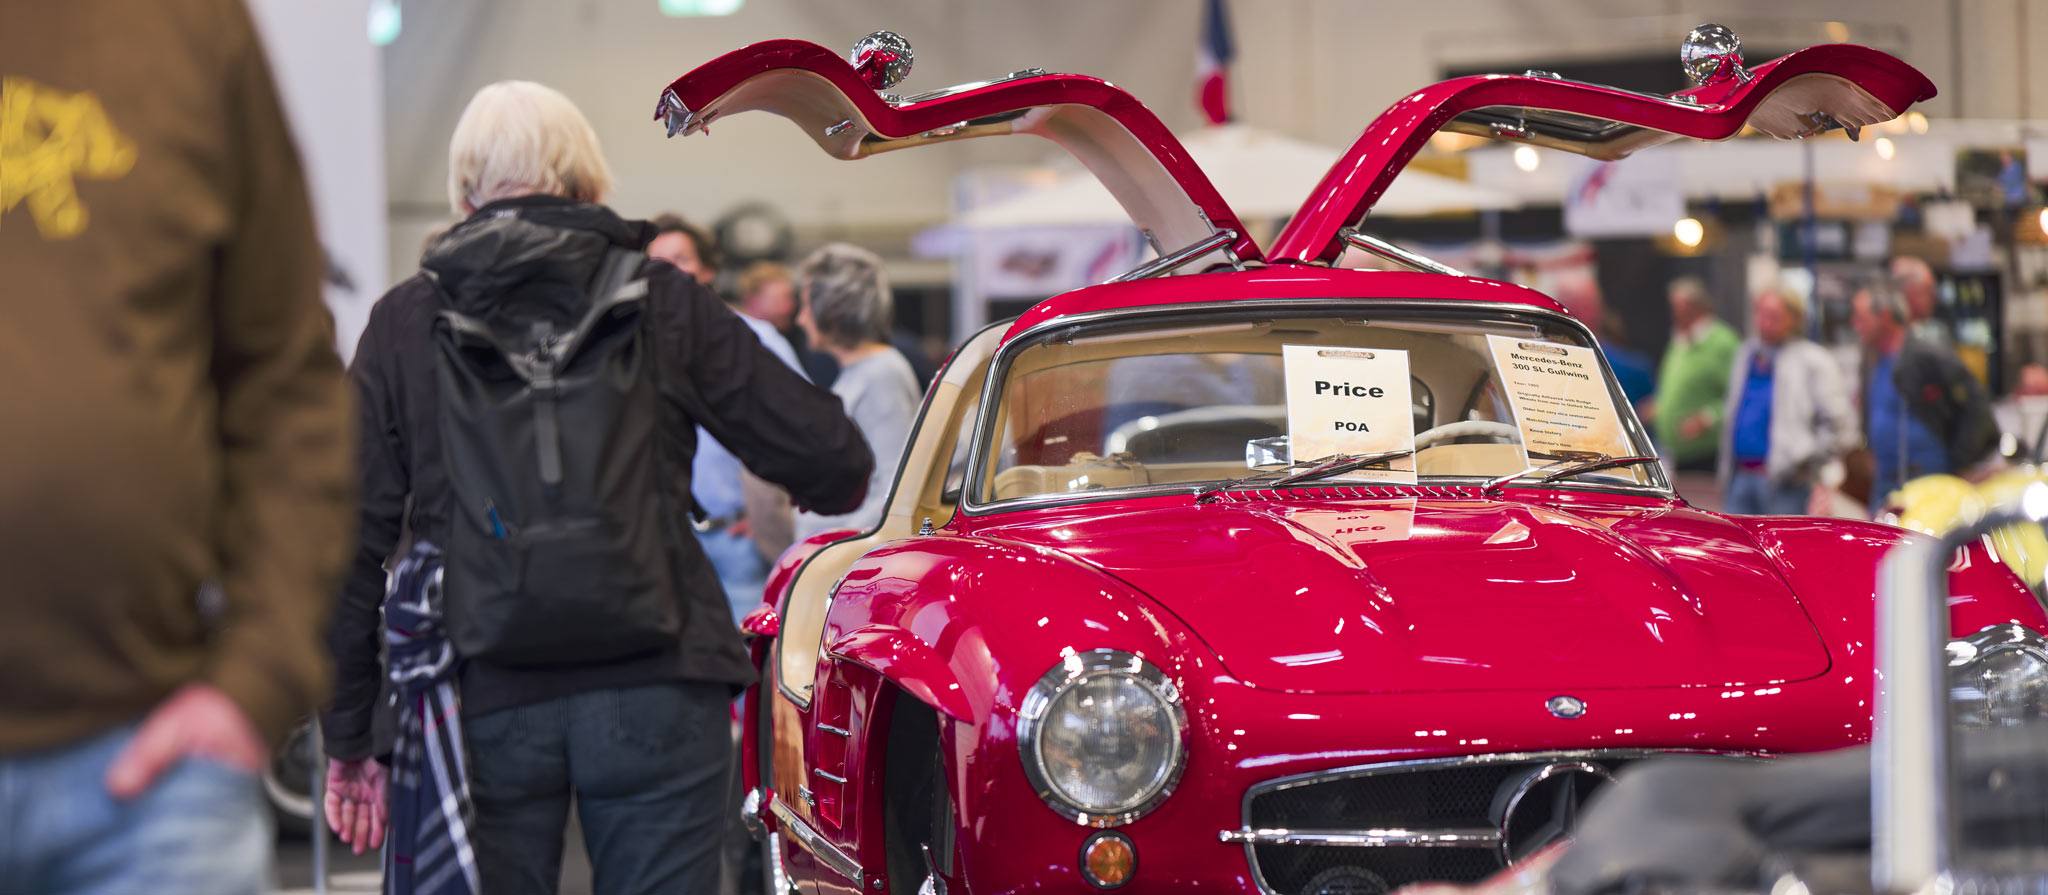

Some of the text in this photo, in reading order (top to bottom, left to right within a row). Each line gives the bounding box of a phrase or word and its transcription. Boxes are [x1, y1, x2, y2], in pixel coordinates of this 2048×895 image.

[1510, 352, 1584, 368] Mercedes-Benz
[1512, 362, 1530, 371] 300
[1548, 368, 1590, 380] Gullwing
[1315, 381, 1384, 398] Price
[1335, 422, 1369, 432] POA
